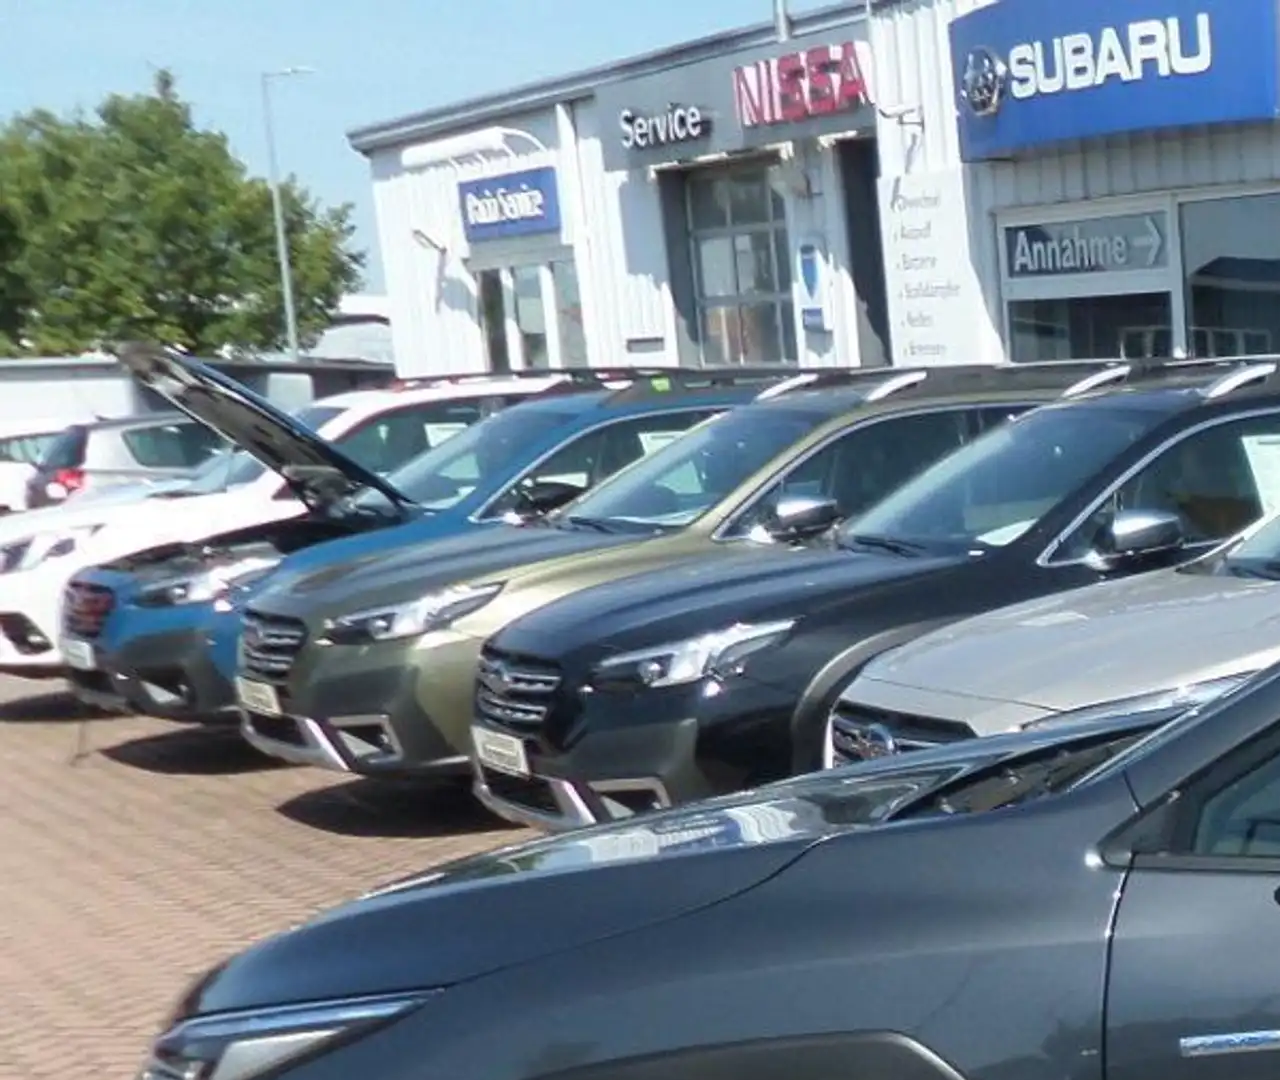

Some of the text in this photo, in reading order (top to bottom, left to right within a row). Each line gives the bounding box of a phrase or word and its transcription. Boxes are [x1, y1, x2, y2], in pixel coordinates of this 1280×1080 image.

[733, 41, 873, 127] NISSA
[1008, 13, 1212, 99] SUBARU
[619, 102, 701, 149] Service
[1014, 225, 1128, 272] Annahme
